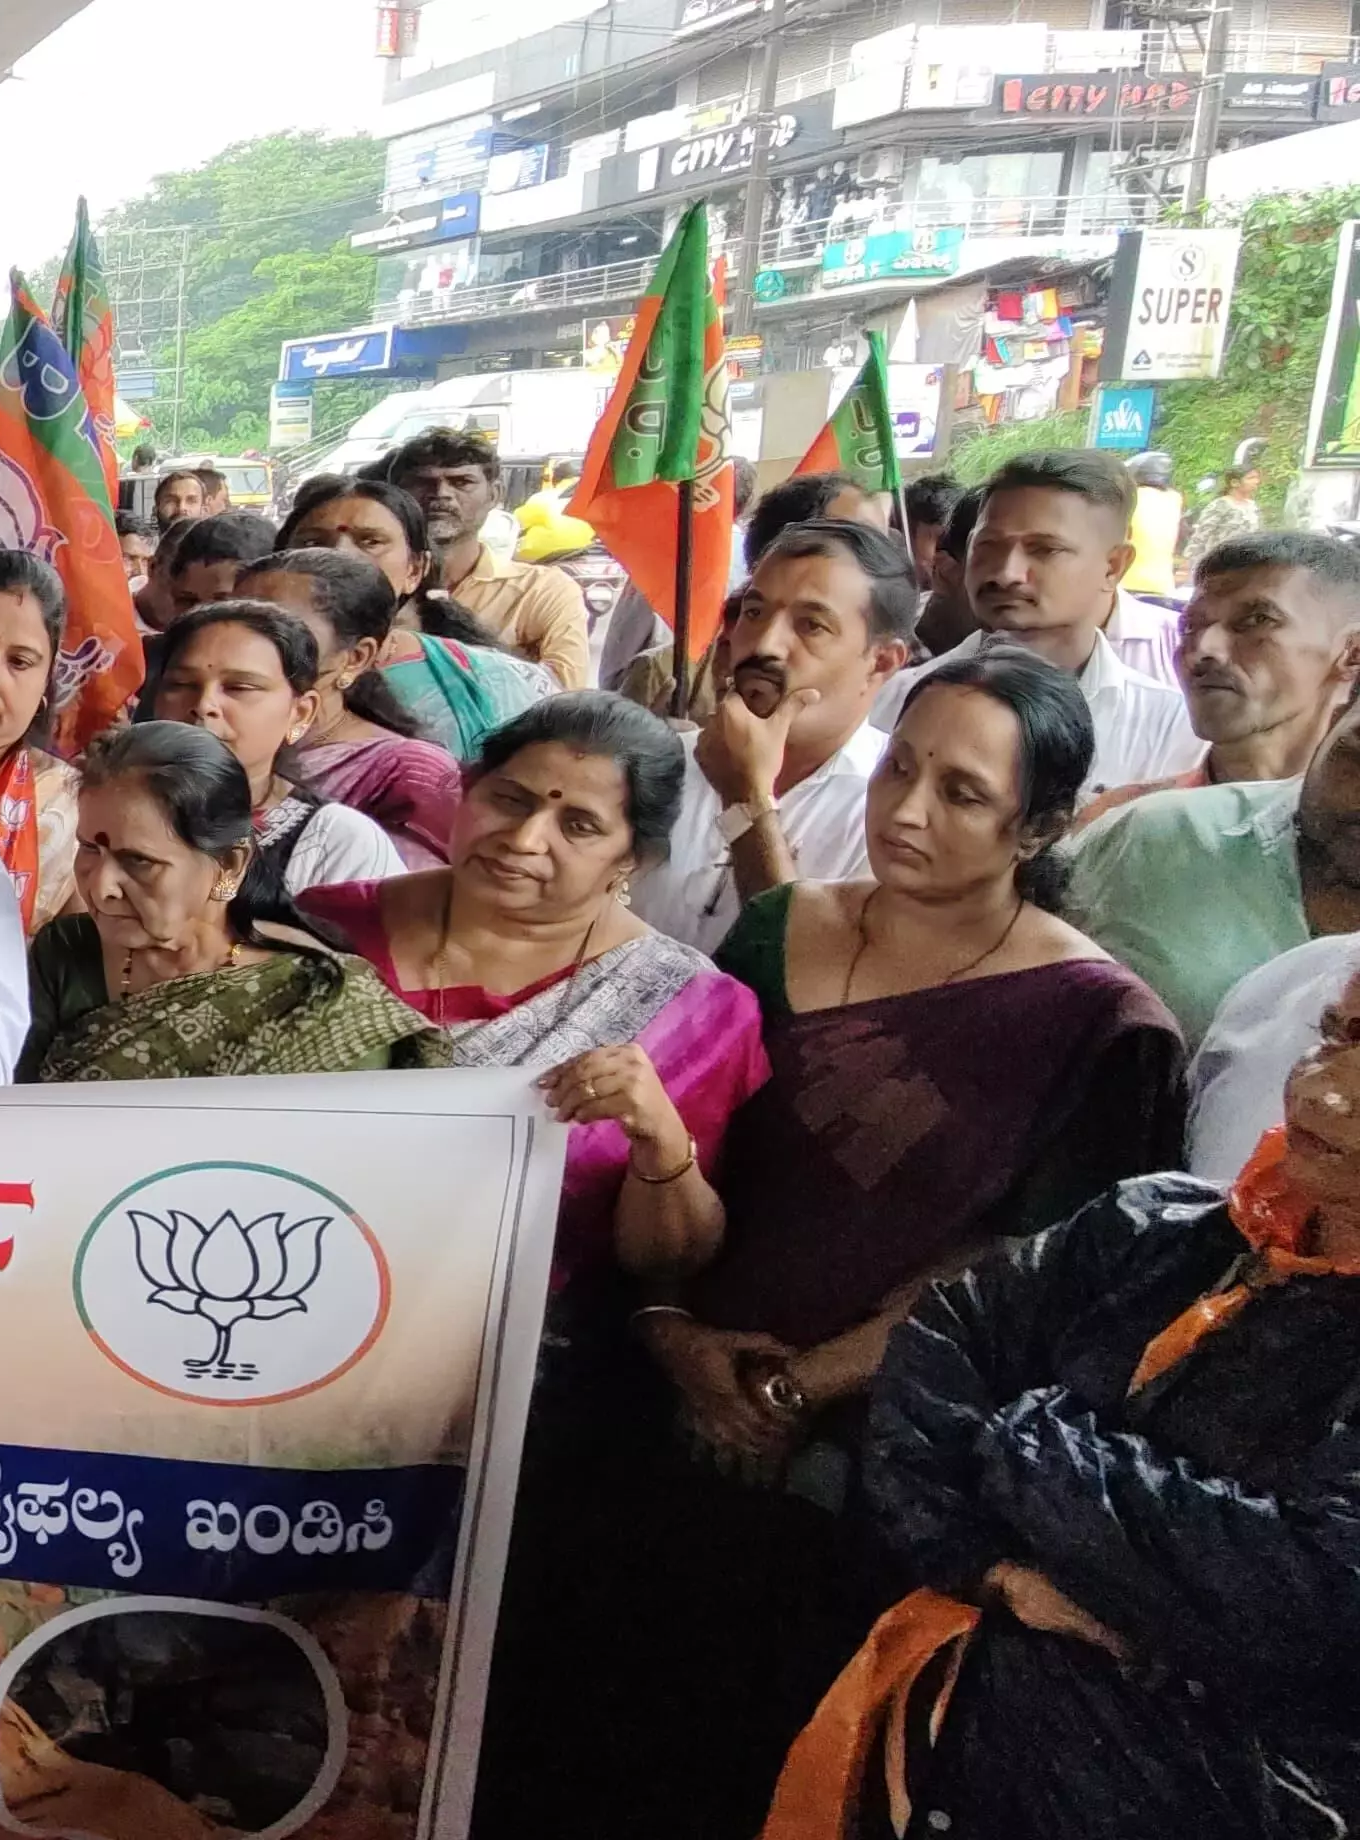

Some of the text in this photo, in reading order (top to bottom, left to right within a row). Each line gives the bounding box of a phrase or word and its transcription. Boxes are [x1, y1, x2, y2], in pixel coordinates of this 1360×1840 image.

[1026, 84, 1108, 113] CITY
[671, 132, 735, 176] CITY
[1137, 287, 1223, 325] SUPER
[185, 1498, 394, 1555] ಖಂಡಿಸಿ
